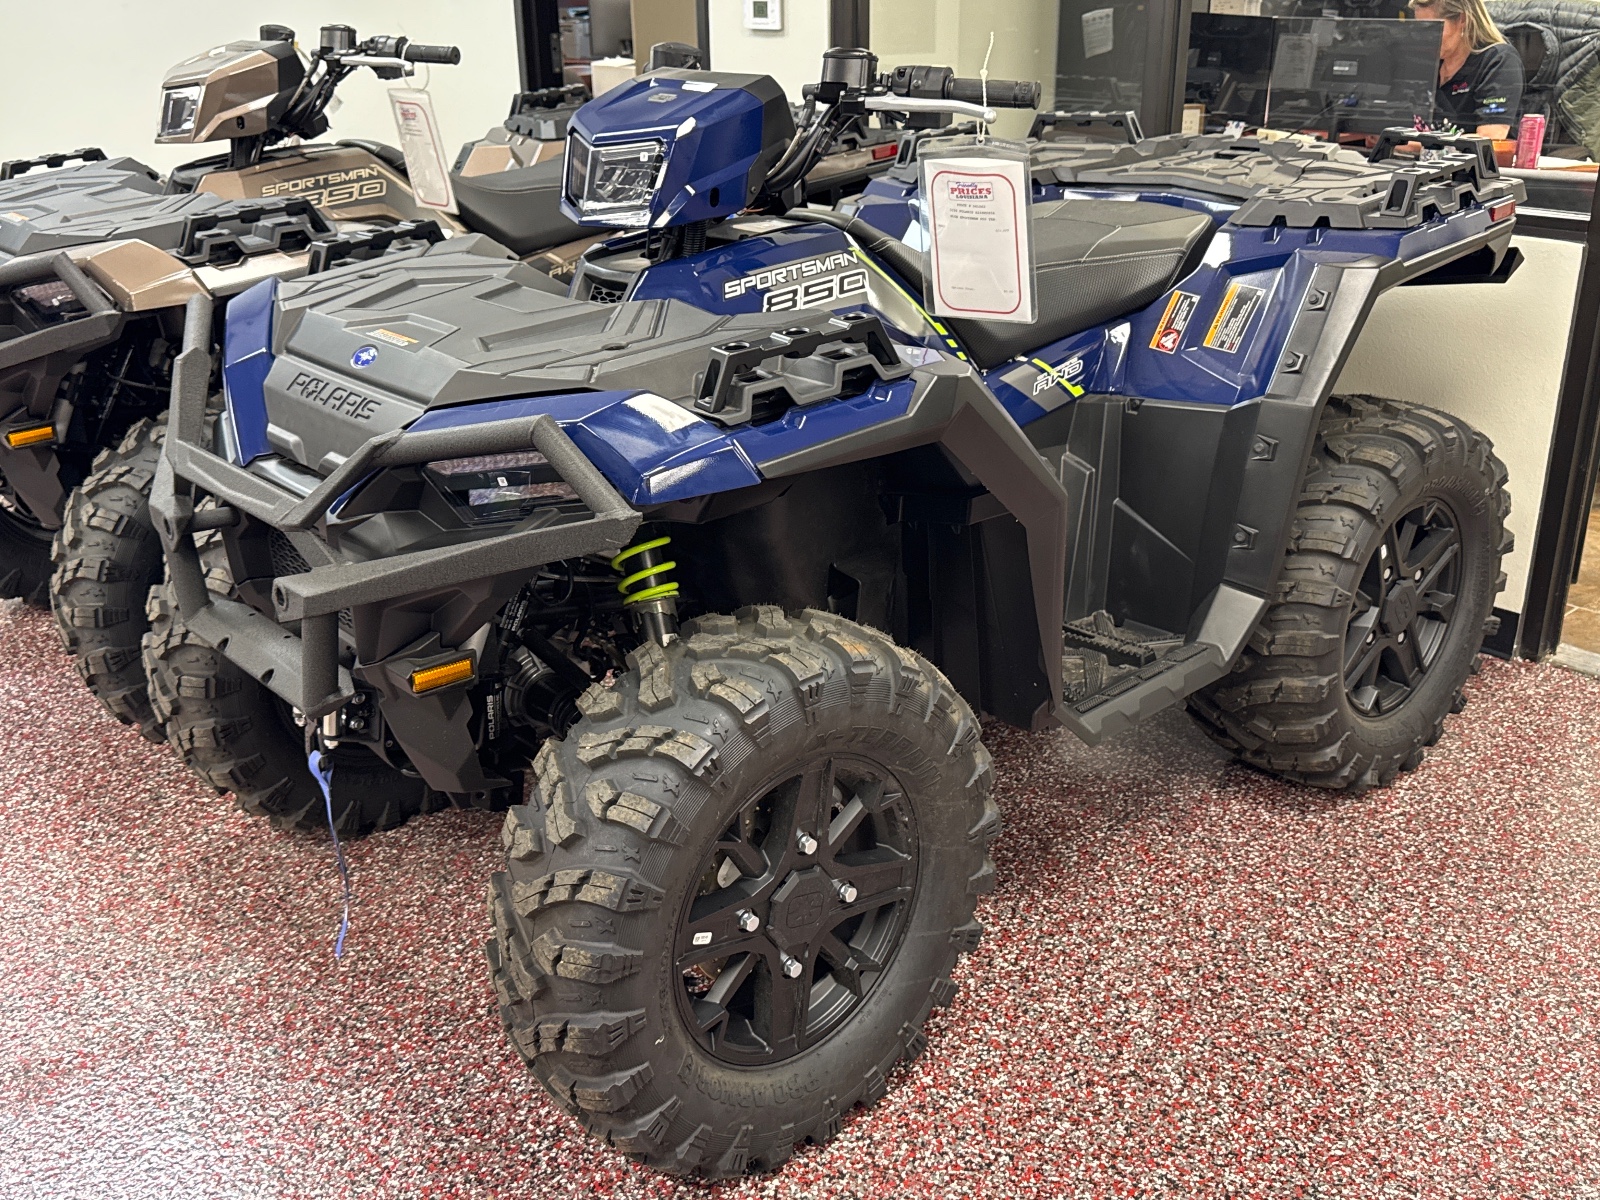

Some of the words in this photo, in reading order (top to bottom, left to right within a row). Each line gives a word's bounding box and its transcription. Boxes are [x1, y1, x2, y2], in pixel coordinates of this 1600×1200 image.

[262, 167, 378, 197] SPORTSMAN
[950, 187, 991, 195] PRICES
[548, 261, 576, 278] AW
[724, 252, 859, 300] SPORTSMAN
[762, 268, 869, 313] 850
[286, 371, 382, 421] POLARIS
[1033, 360, 1083, 396] AWD
[486, 695, 495, 740] POLARIS
